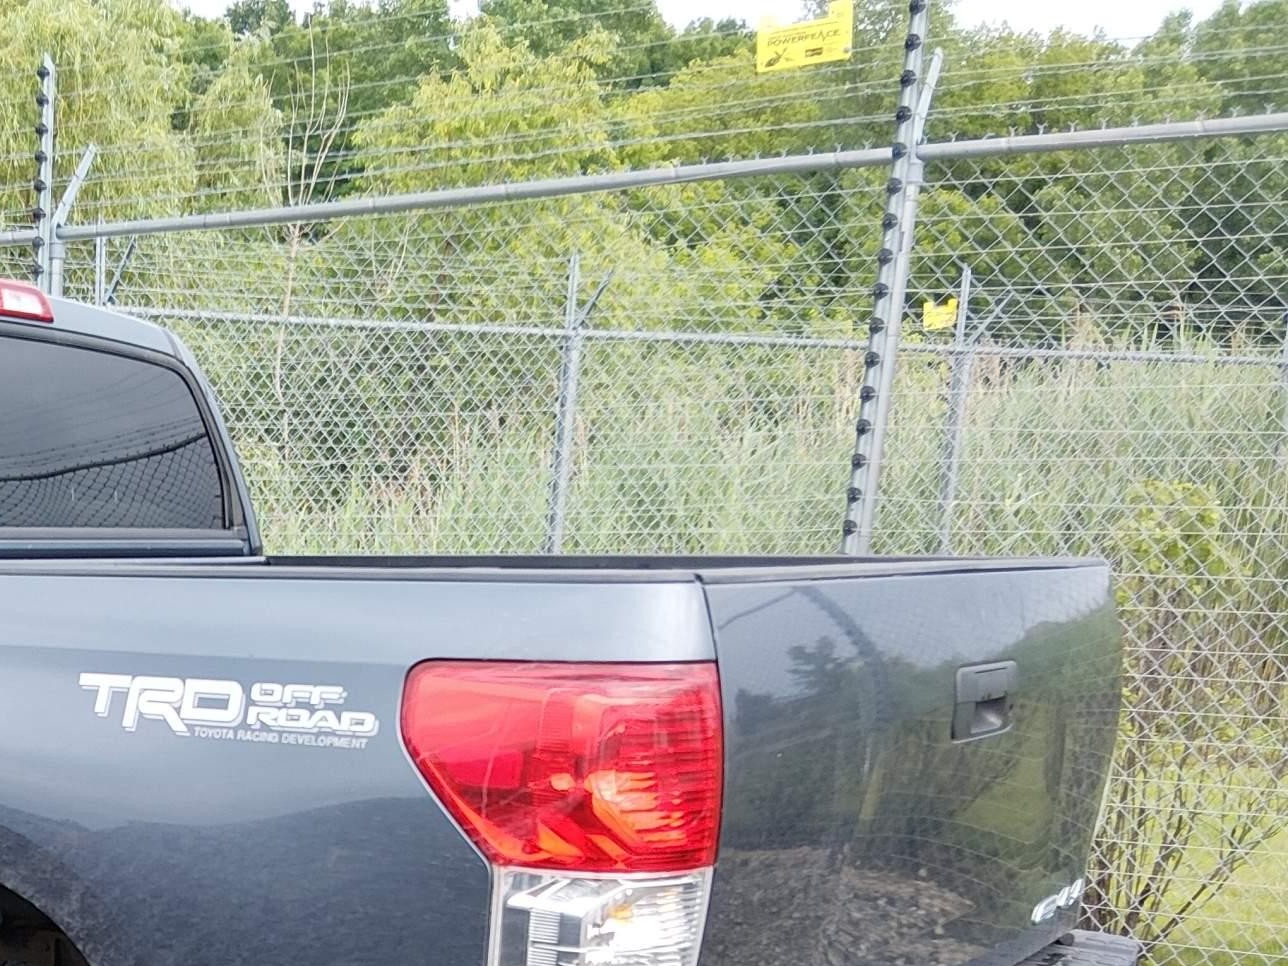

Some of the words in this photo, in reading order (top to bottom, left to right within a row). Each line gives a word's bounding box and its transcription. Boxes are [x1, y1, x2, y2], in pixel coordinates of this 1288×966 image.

[78, 672, 247, 736] TRD
[249, 682, 349, 707] OFF
[245, 705, 380, 737] ROAD
[193, 725, 235, 741] TOYOTA
[236, 730, 279, 744] RACING
[281, 733, 369, 751] DEVELOPMENT
